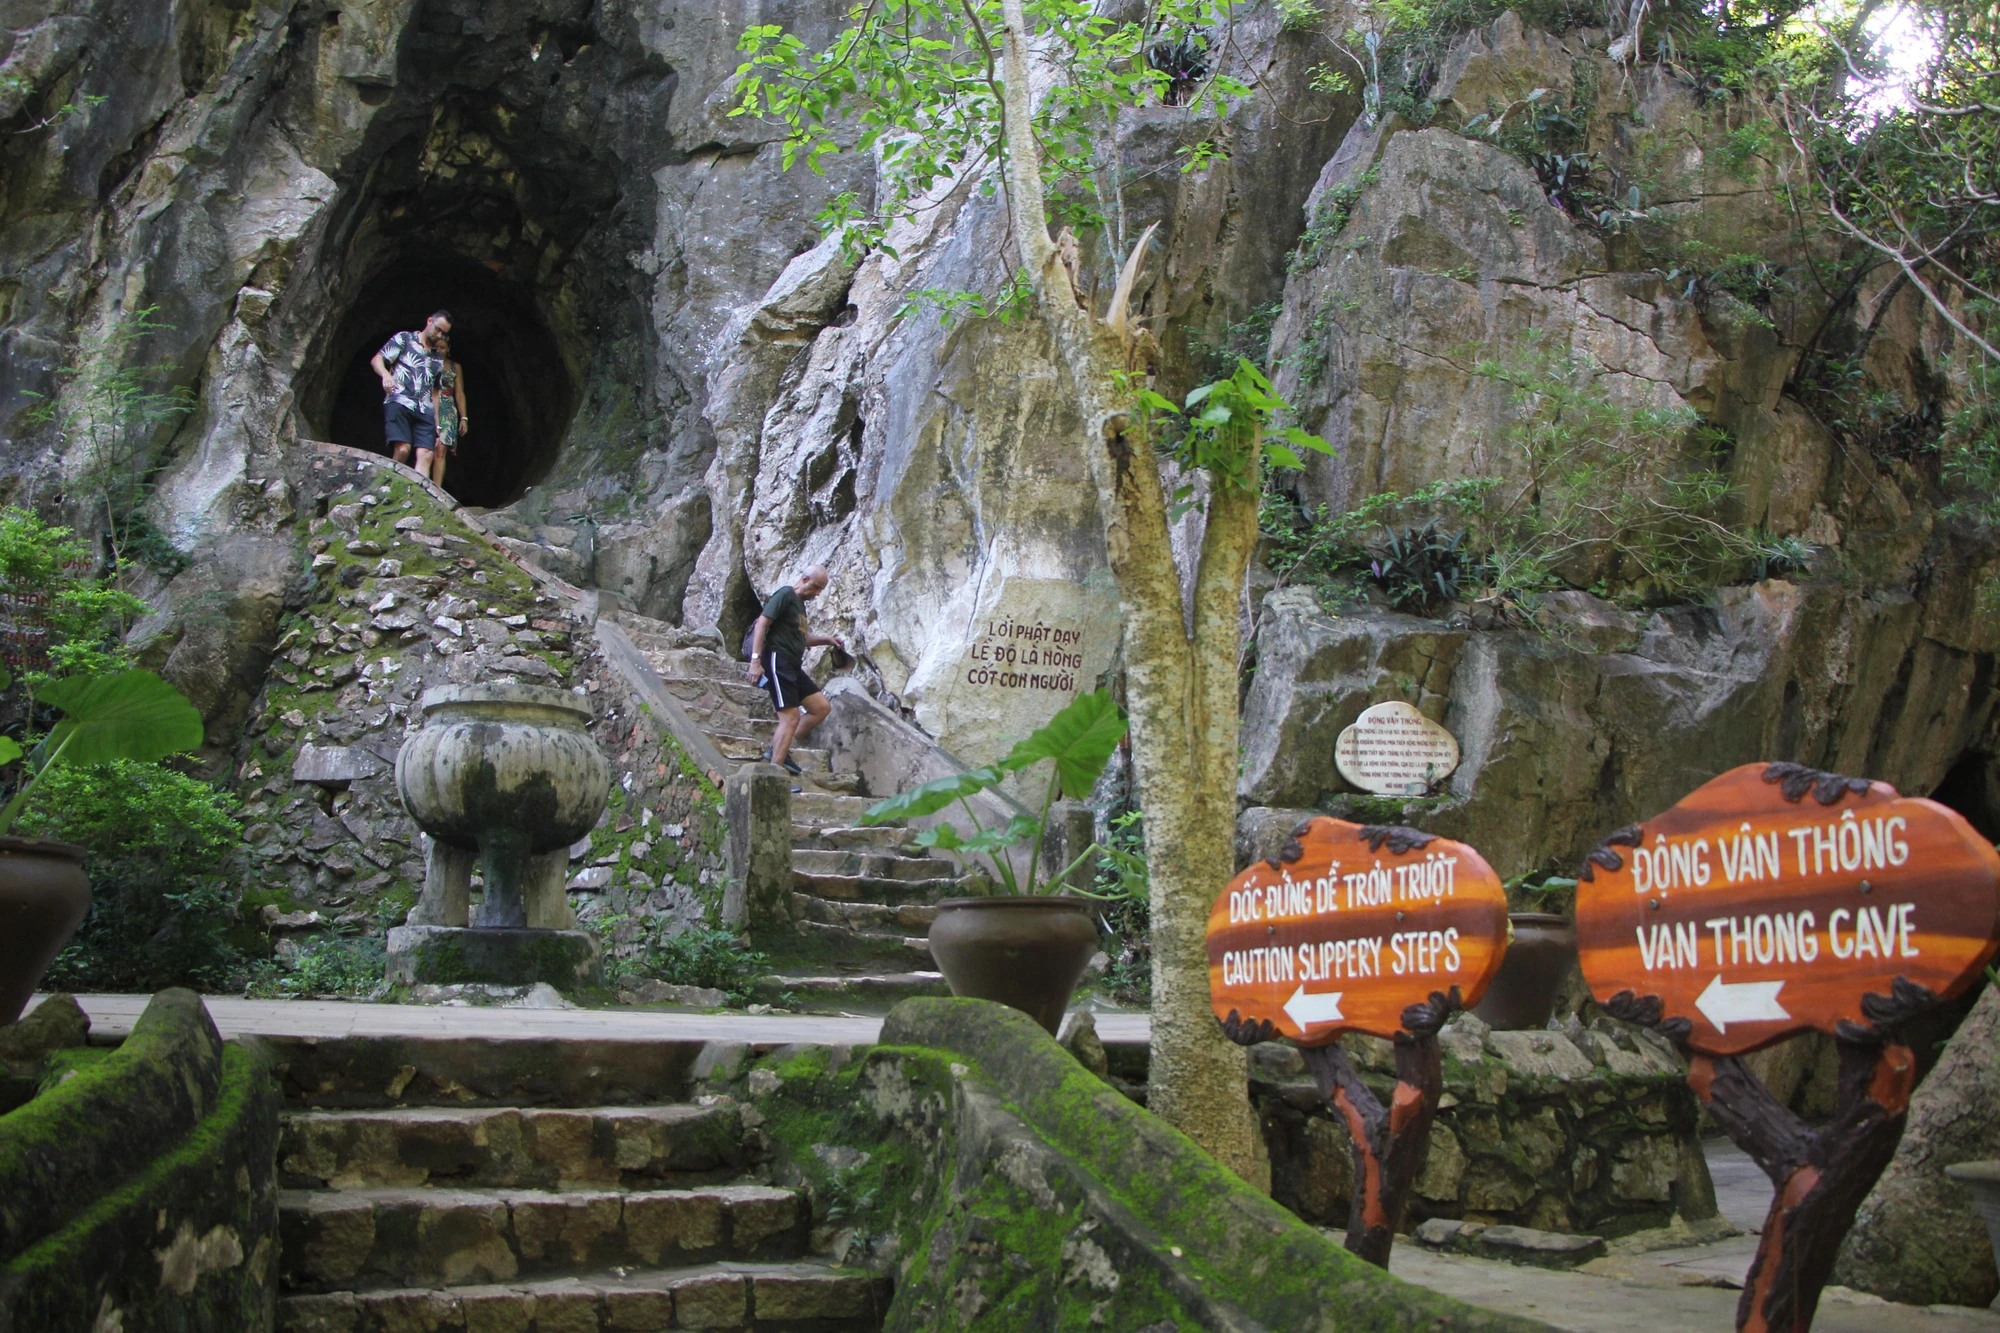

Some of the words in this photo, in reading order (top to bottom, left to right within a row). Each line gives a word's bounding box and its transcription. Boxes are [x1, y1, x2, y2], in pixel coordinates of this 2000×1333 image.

[989, 615, 1014, 638] LỜI
[1016, 621, 1051, 644] PHẬT
[1053, 629, 1081, 646] DẠY
[995, 644, 1017, 667] ĐỘ
[1043, 645, 1082, 669] NÒNG
[968, 663, 998, 685] CỐT
[1000, 672, 1028, 688] CON
[1030, 669, 1075, 692] NGƯỜI
[1630, 833, 1711, 898] ĐỘNG
[1718, 822, 1780, 882] VÂN
[1788, 809, 1909, 876] THÔNG
[1229, 875, 1263, 924] DỐC
[1265, 869, 1312, 919] ĐỨNG
[1316, 860, 1341, 914] DỄ
[1396, 852, 1457, 905] TRƯỢT
[1223, 946, 1294, 986] CAUTION
[1298, 936, 1382, 982] SLIPPERY
[1390, 927, 1461, 976] STEPS
[1636, 920, 1697, 971] VAN
[1705, 909, 1818, 966] THONG
[1828, 902, 1920, 960] CAVE
